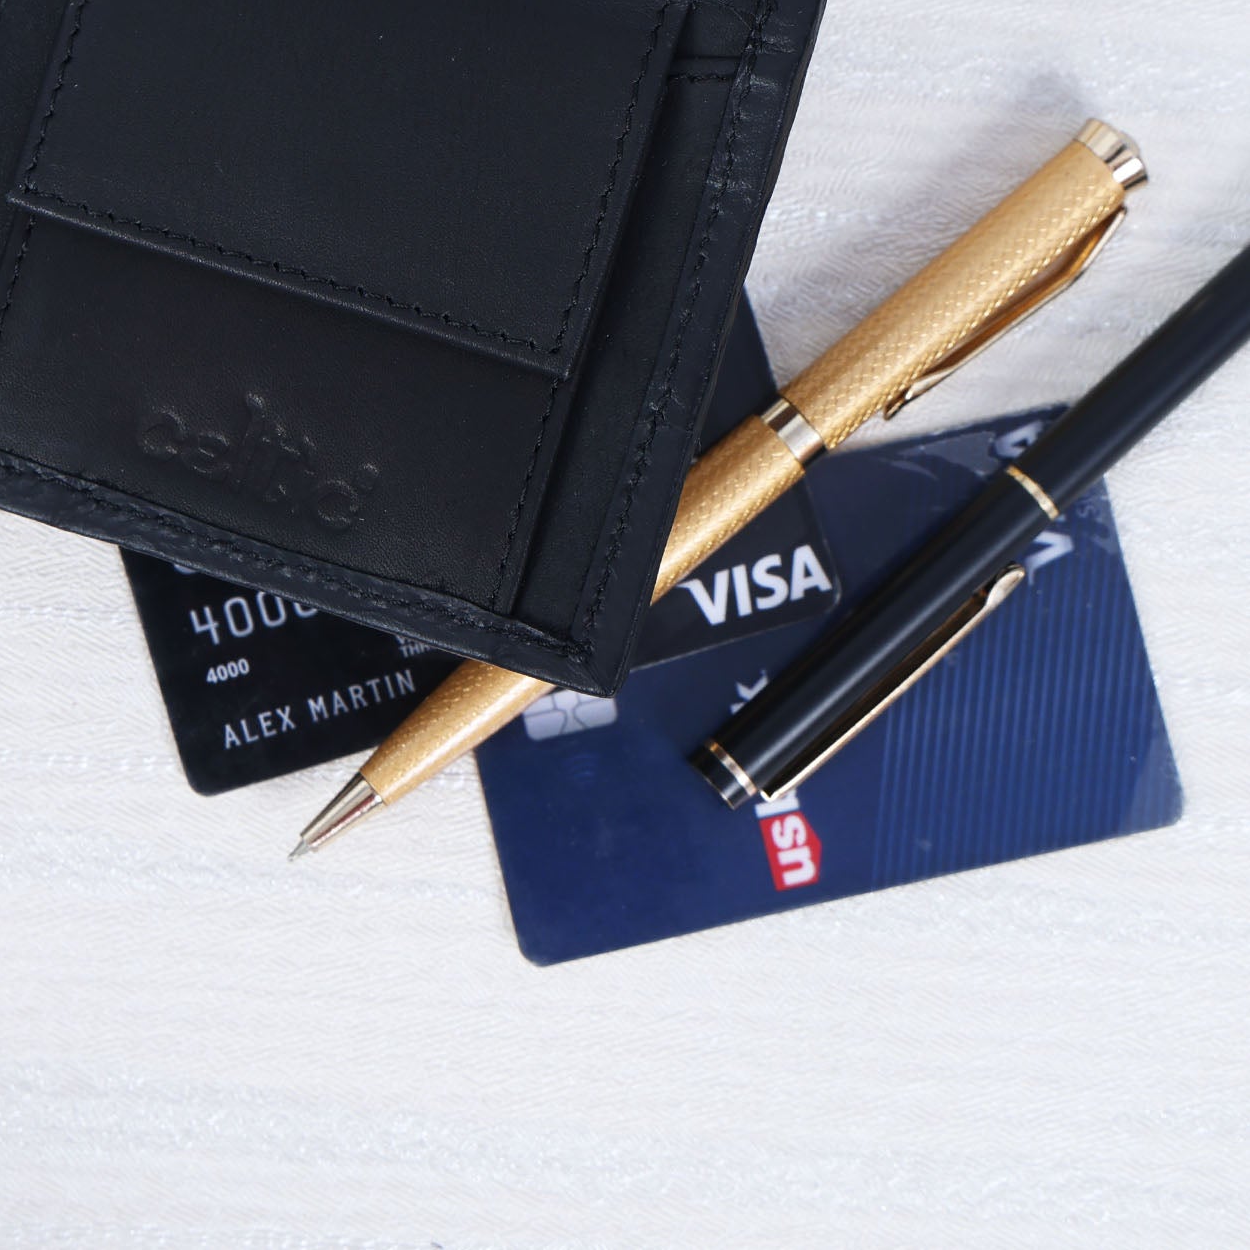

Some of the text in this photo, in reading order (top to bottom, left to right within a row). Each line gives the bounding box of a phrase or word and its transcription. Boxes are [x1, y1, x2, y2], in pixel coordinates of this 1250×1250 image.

[677, 544, 832, 626] VISA
[206, 658, 250, 684] 4000
[224, 669, 416, 749] ALEX MARTIN
